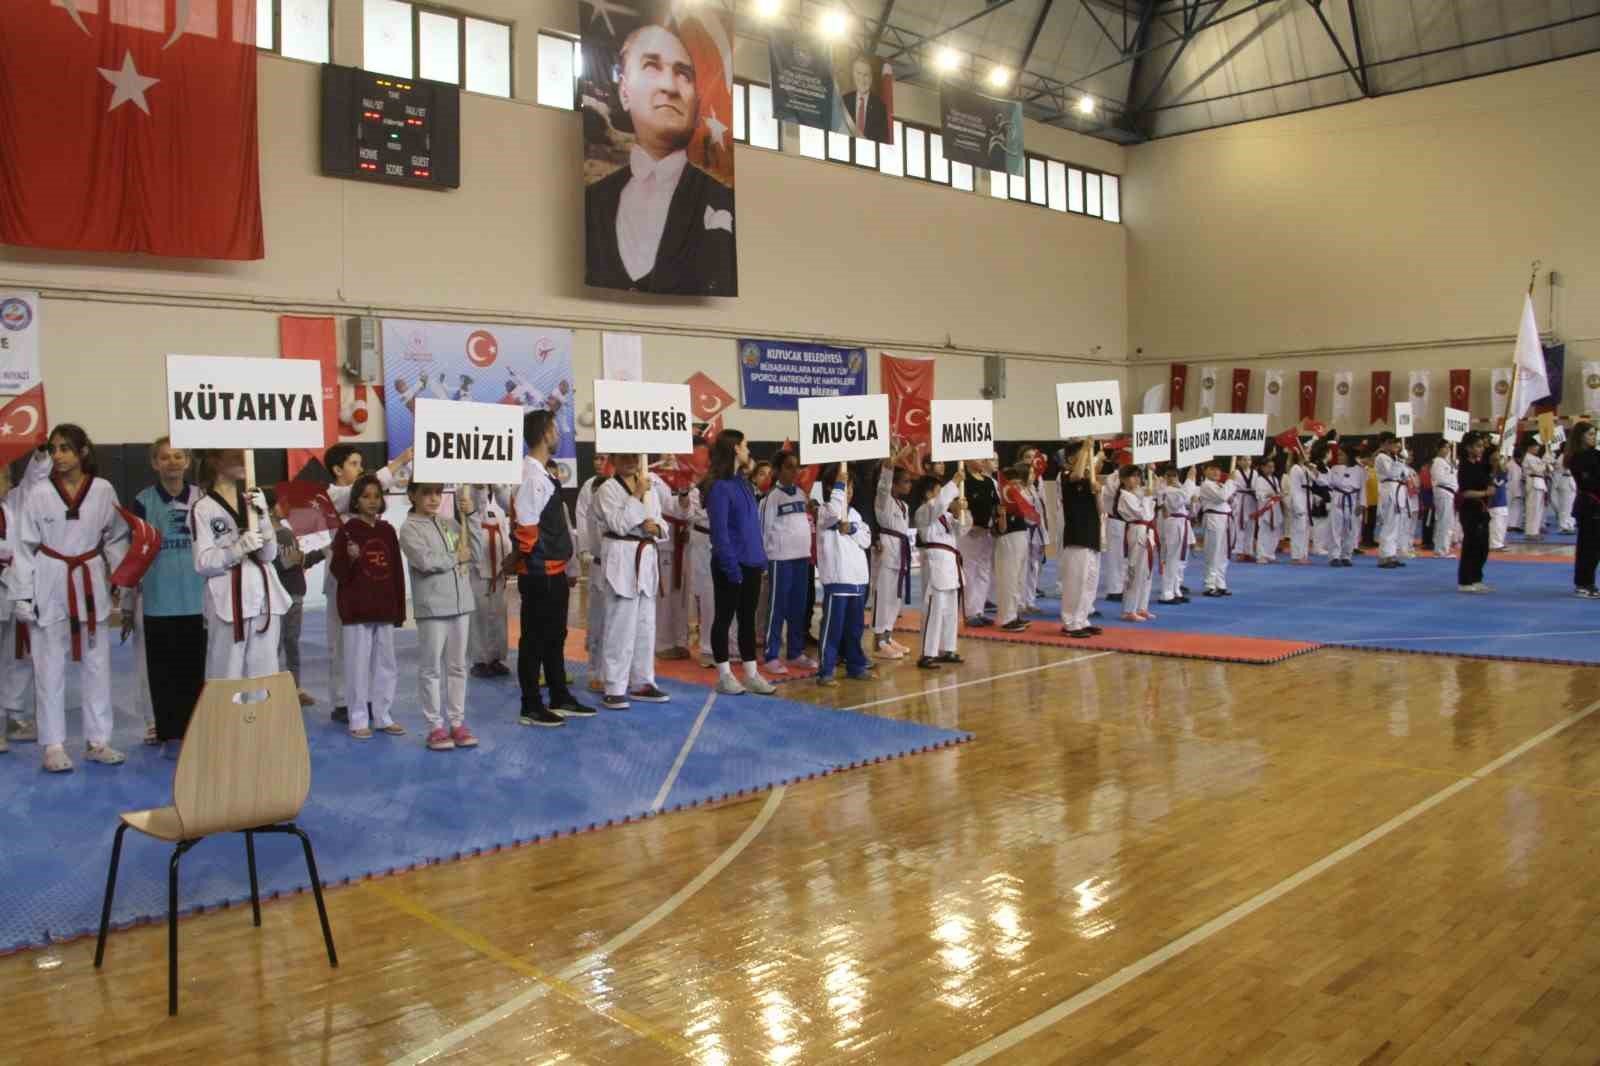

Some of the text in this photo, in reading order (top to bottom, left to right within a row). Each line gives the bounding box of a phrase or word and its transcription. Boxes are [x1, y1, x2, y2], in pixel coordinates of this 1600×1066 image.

[174, 384, 318, 421] KÜTAHYA
[1066, 398, 1113, 419] KONYA
[600, 406, 688, 431] BALIKESİR
[812, 414, 879, 444] MUĞLA
[941, 417, 992, 443] MANİSA
[425, 426, 514, 461] DENİZLİ
[1136, 429, 1169, 448] ISPARTA
[1179, 431, 1210, 453] BURDUR
[1213, 428, 1265, 442] KARAMAN
